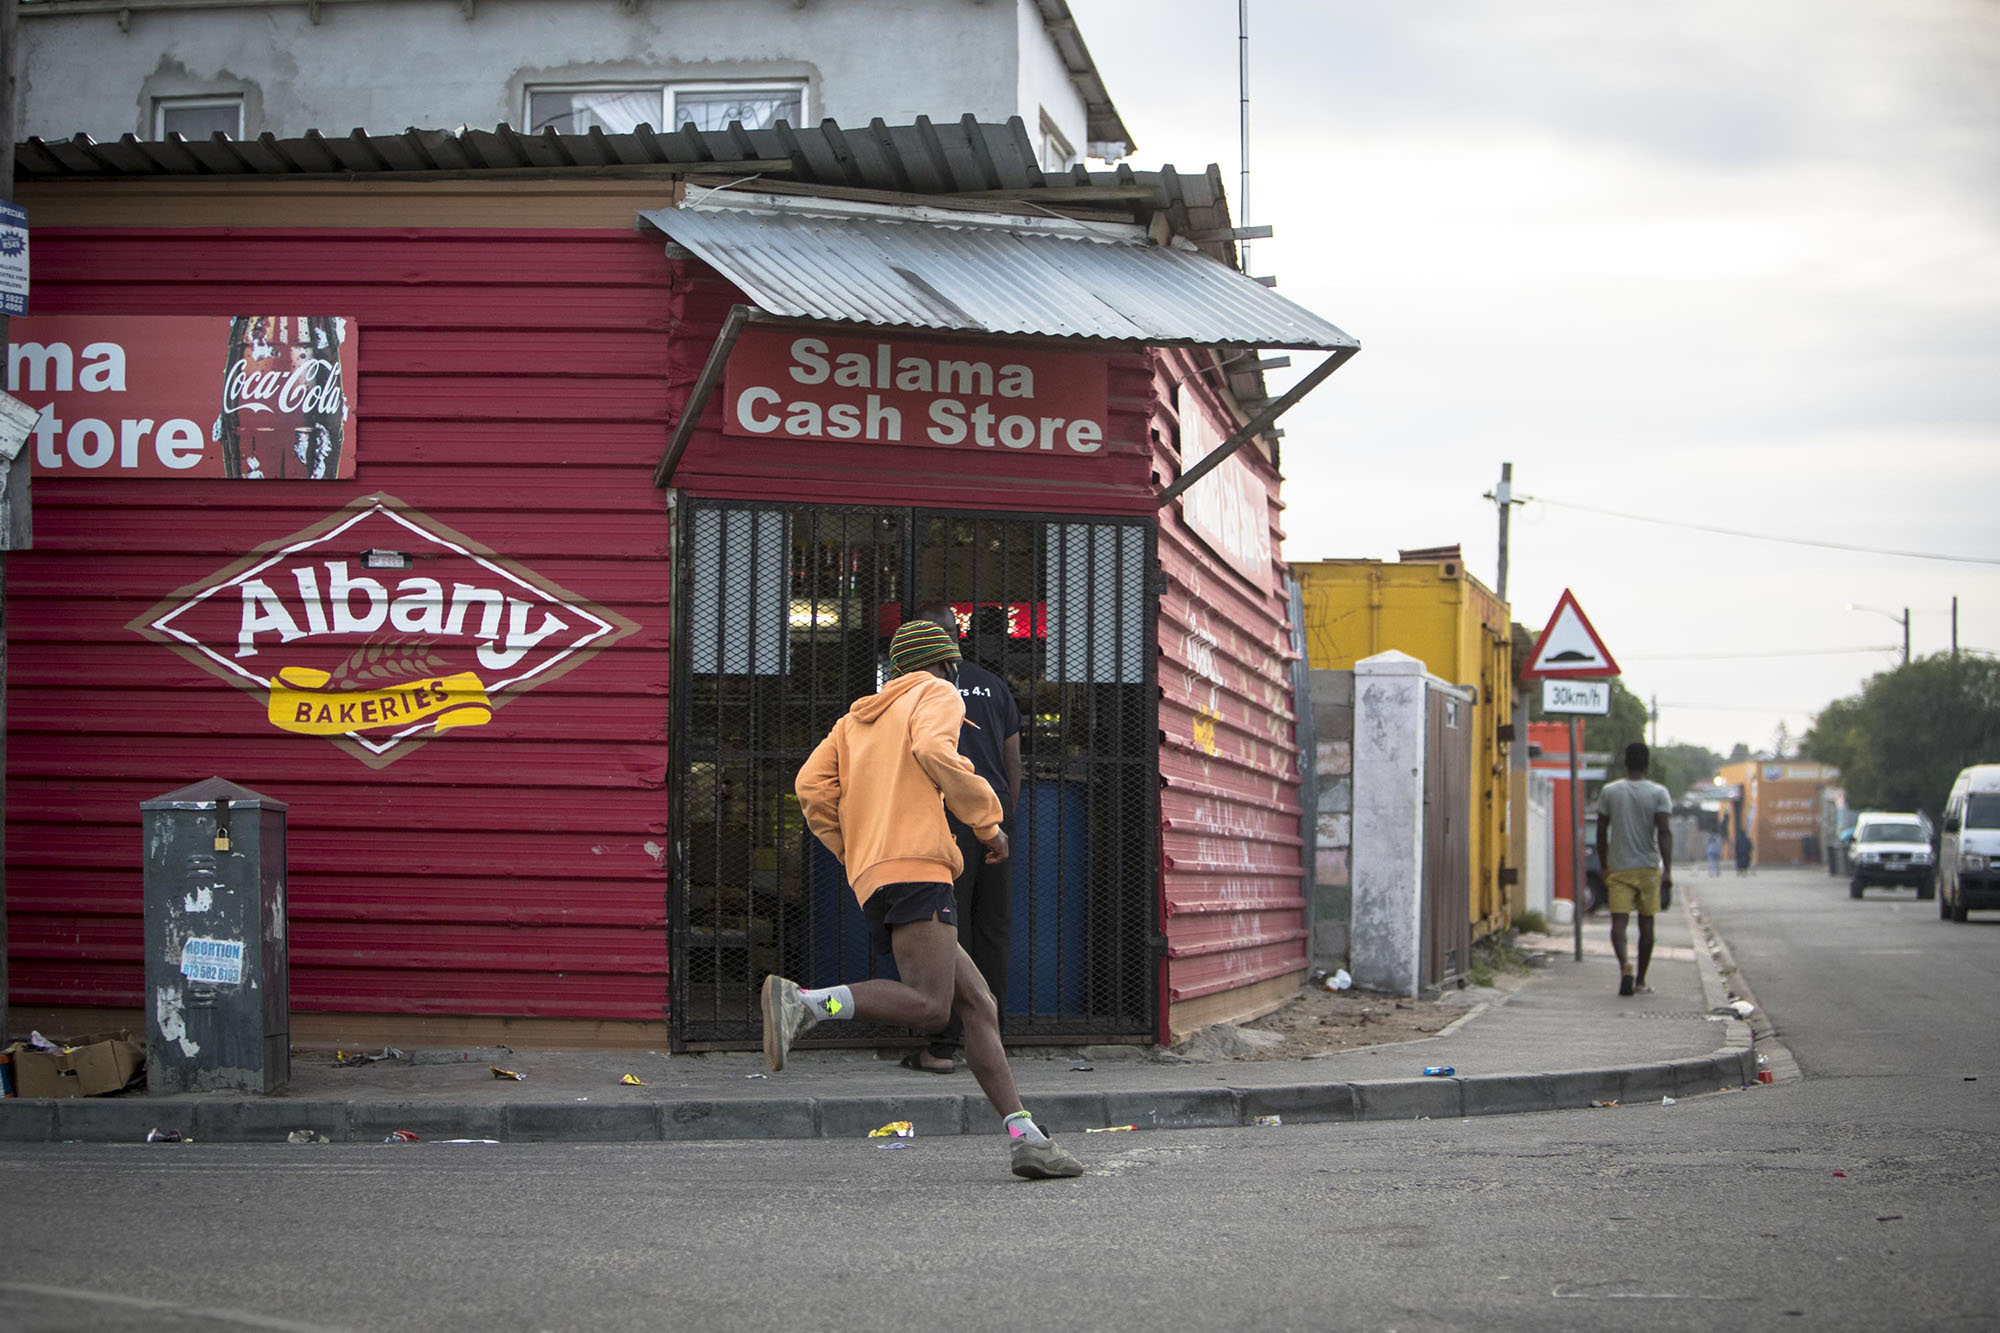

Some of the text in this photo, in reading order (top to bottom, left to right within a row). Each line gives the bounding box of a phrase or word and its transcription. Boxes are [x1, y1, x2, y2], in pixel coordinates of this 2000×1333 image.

[8, 342, 126, 392] ma
[224, 359, 341, 414] Coca-Cola
[788, 338, 1034, 399] Salama
[736, 386, 1103, 453] Cash Store
[234, 561, 569, 670] Albany
[295, 681, 449, 724] BAKERIES
[972, 686, 991, 697] 4.1
[1552, 686, 1601, 706] 30km/h
[186, 941, 240, 959] ABORTION
[200, 965, 216, 980] 582
[218, 967, 239, 982] 8193
